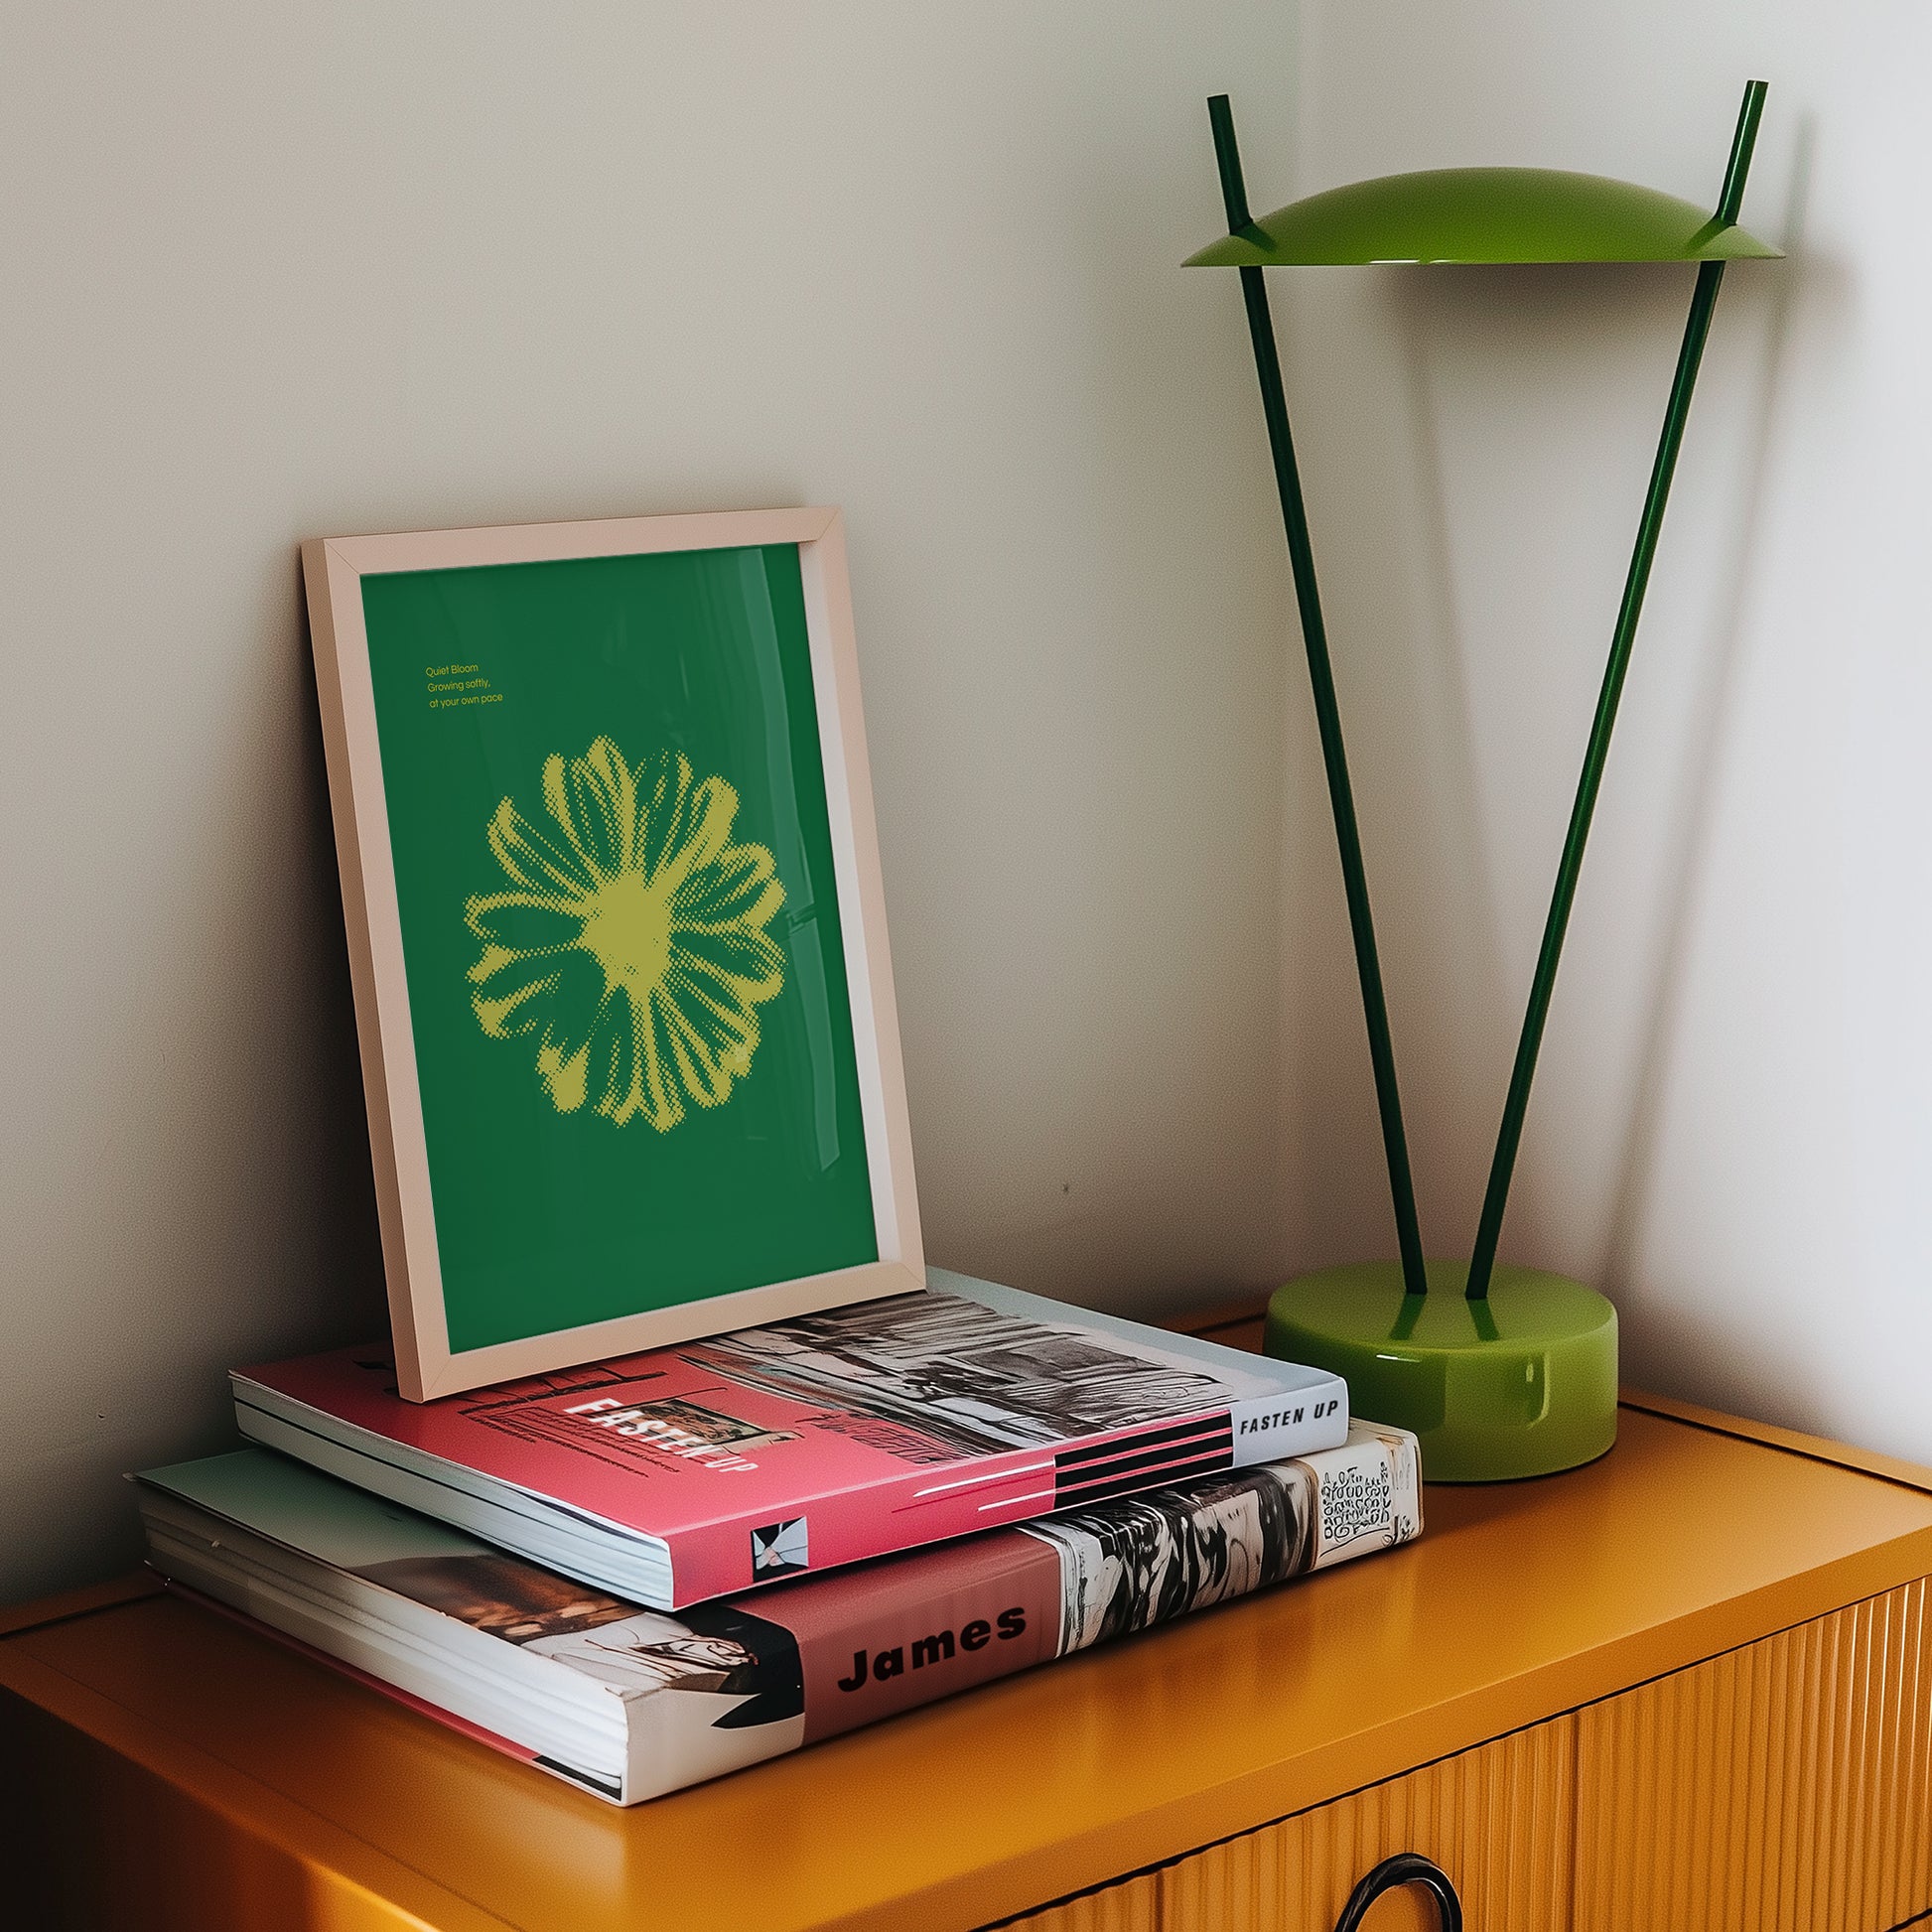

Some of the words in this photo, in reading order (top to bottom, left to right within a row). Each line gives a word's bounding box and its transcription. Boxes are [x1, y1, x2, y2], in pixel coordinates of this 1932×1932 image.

[425, 666, 450, 678] Quiet
[451, 664, 479, 674] Bloom
[427, 681, 465, 692] Growing
[465, 678, 491, 689] softly,
[429, 699, 439, 708] at
[440, 698, 460, 709] your
[461, 696, 480, 705] own
[481, 694, 503, 705] pace
[1240, 1408, 1304, 1435] FASTEN
[1313, 1400, 1338, 1419] UP
[563, 1398, 723, 1458] FASTEN
[704, 1454, 759, 1473] UP
[837, 1606, 1027, 1693] James
